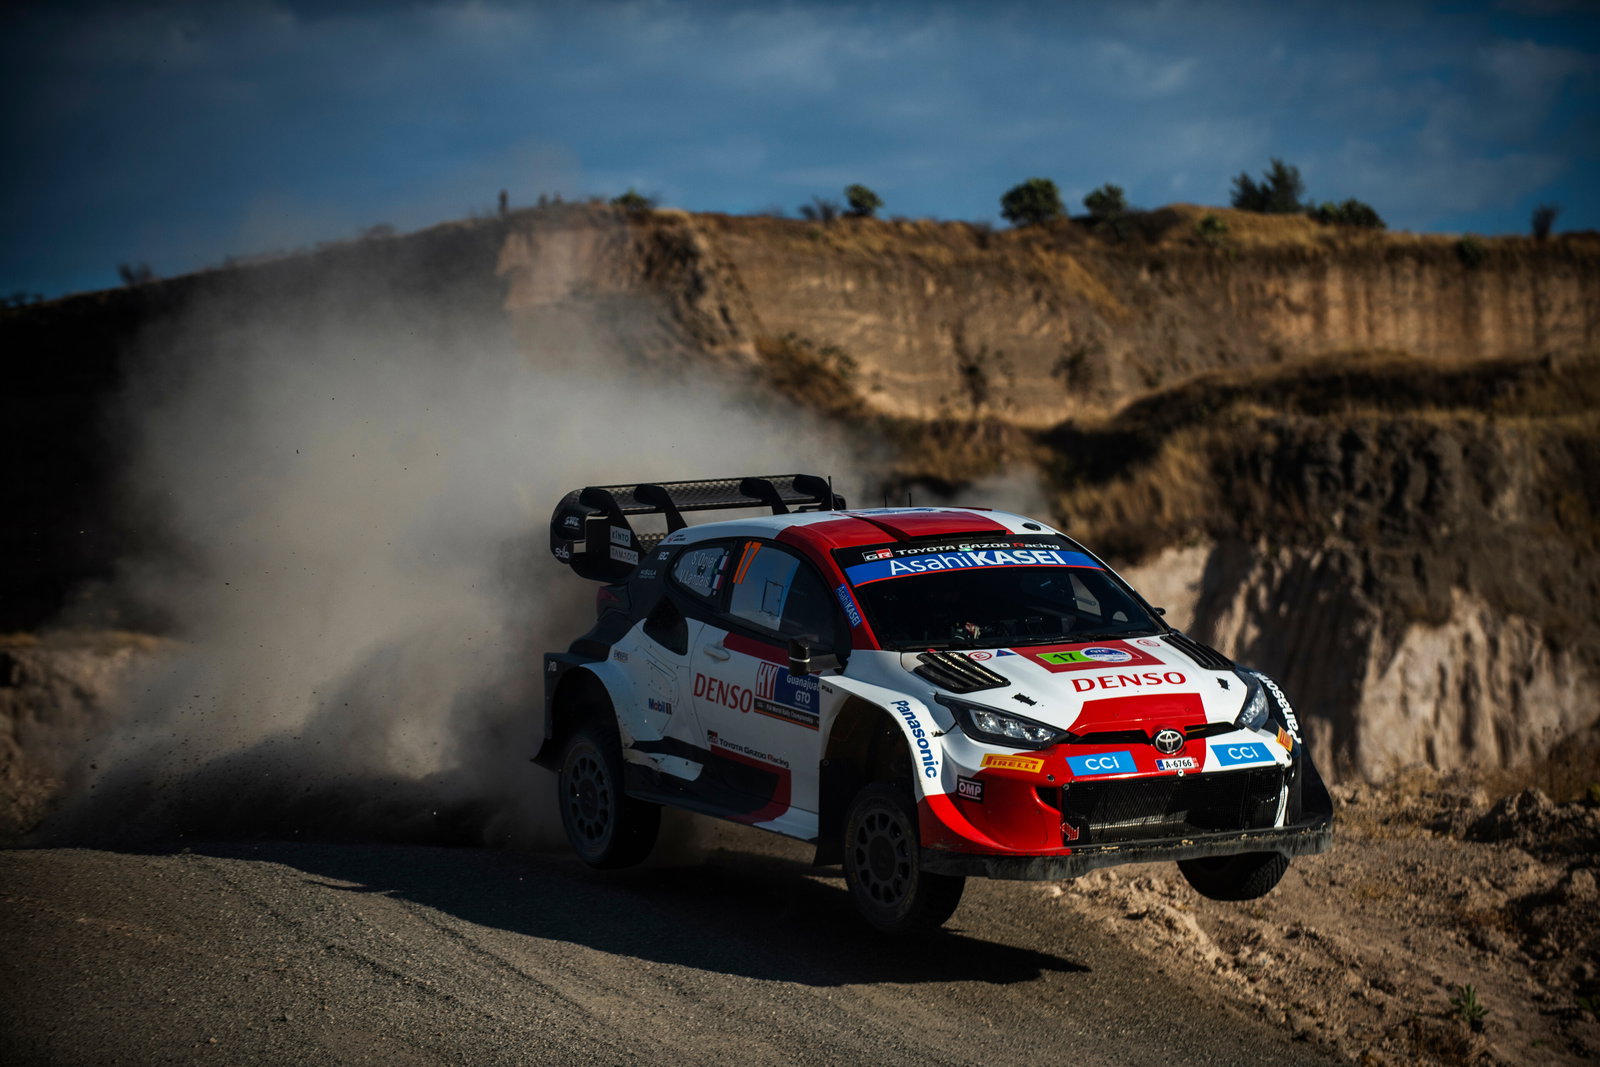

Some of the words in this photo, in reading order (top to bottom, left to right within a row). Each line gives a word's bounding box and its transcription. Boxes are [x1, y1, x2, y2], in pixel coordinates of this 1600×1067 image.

[896, 544, 956, 555] TOYOTA
[959, 542, 1011, 552] GAZOO
[1012, 542, 1060, 551] Racing
[732, 540, 764, 585] 17
[889, 550, 1067, 576] AsahiKASEI
[1053, 652, 1076, 662] 17
[1071, 671, 1186, 693] DENSO
[693, 672, 753, 713] DENSO
[795, 689, 811, 705] GTO
[649, 697, 666, 713] Mobil
[890, 700, 939, 779] Panasonic
[719, 737, 743, 752] TOYOTA
[744, 747, 767, 760] GAZOO
[767, 753, 790, 769] Racing
[984, 755, 1040, 770] PIRELLI
[1165, 759, 1192, 769] A-6766
[958, 781, 982, 797] OMP
